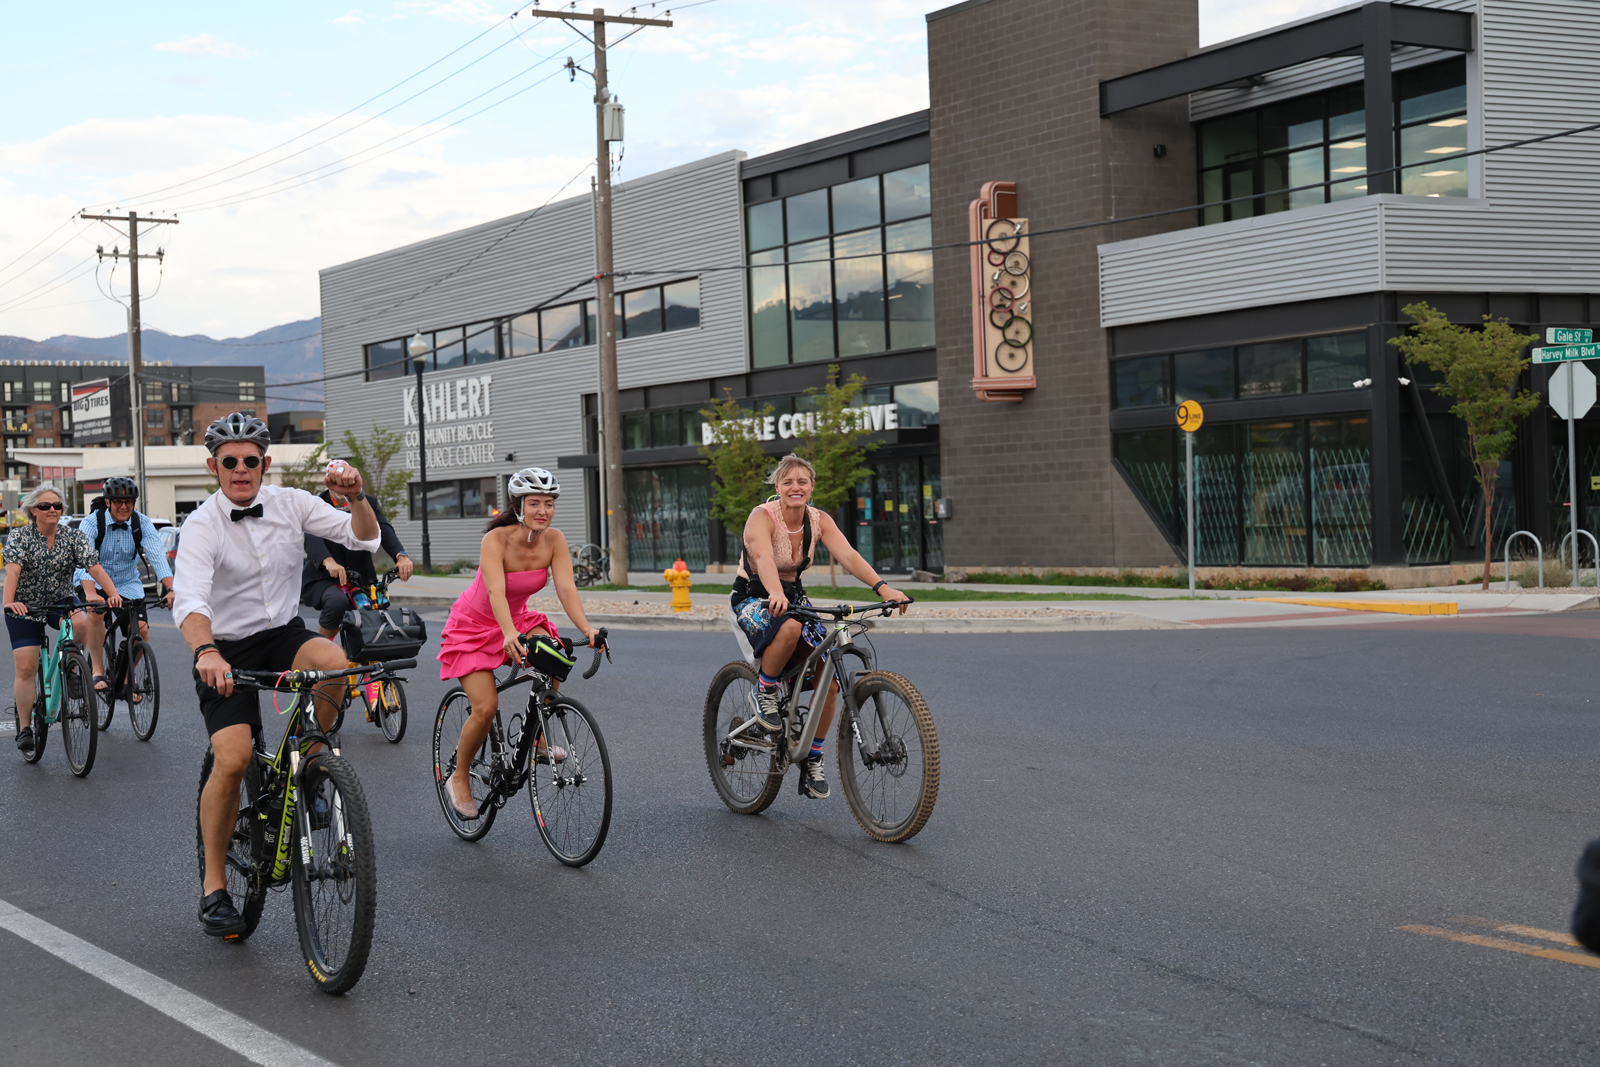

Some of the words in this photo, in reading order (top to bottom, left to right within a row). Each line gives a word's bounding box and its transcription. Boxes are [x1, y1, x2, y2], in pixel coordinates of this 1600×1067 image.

[1557, 330, 1573, 342] Gale
[1574, 331, 1581, 342] St
[1541, 350, 1564, 361] Harvey
[1565, 347, 1579, 358] Milk
[1581, 346, 1595, 357] Blvd
[74, 399, 84, 411] BIG
[90, 395, 109, 408] TIRES
[1177, 405, 1189, 427] 9
[405, 425, 456, 448] COMUNITY
[457, 421, 494, 442] BICYCLE
[456, 442, 495, 466] CENTER
